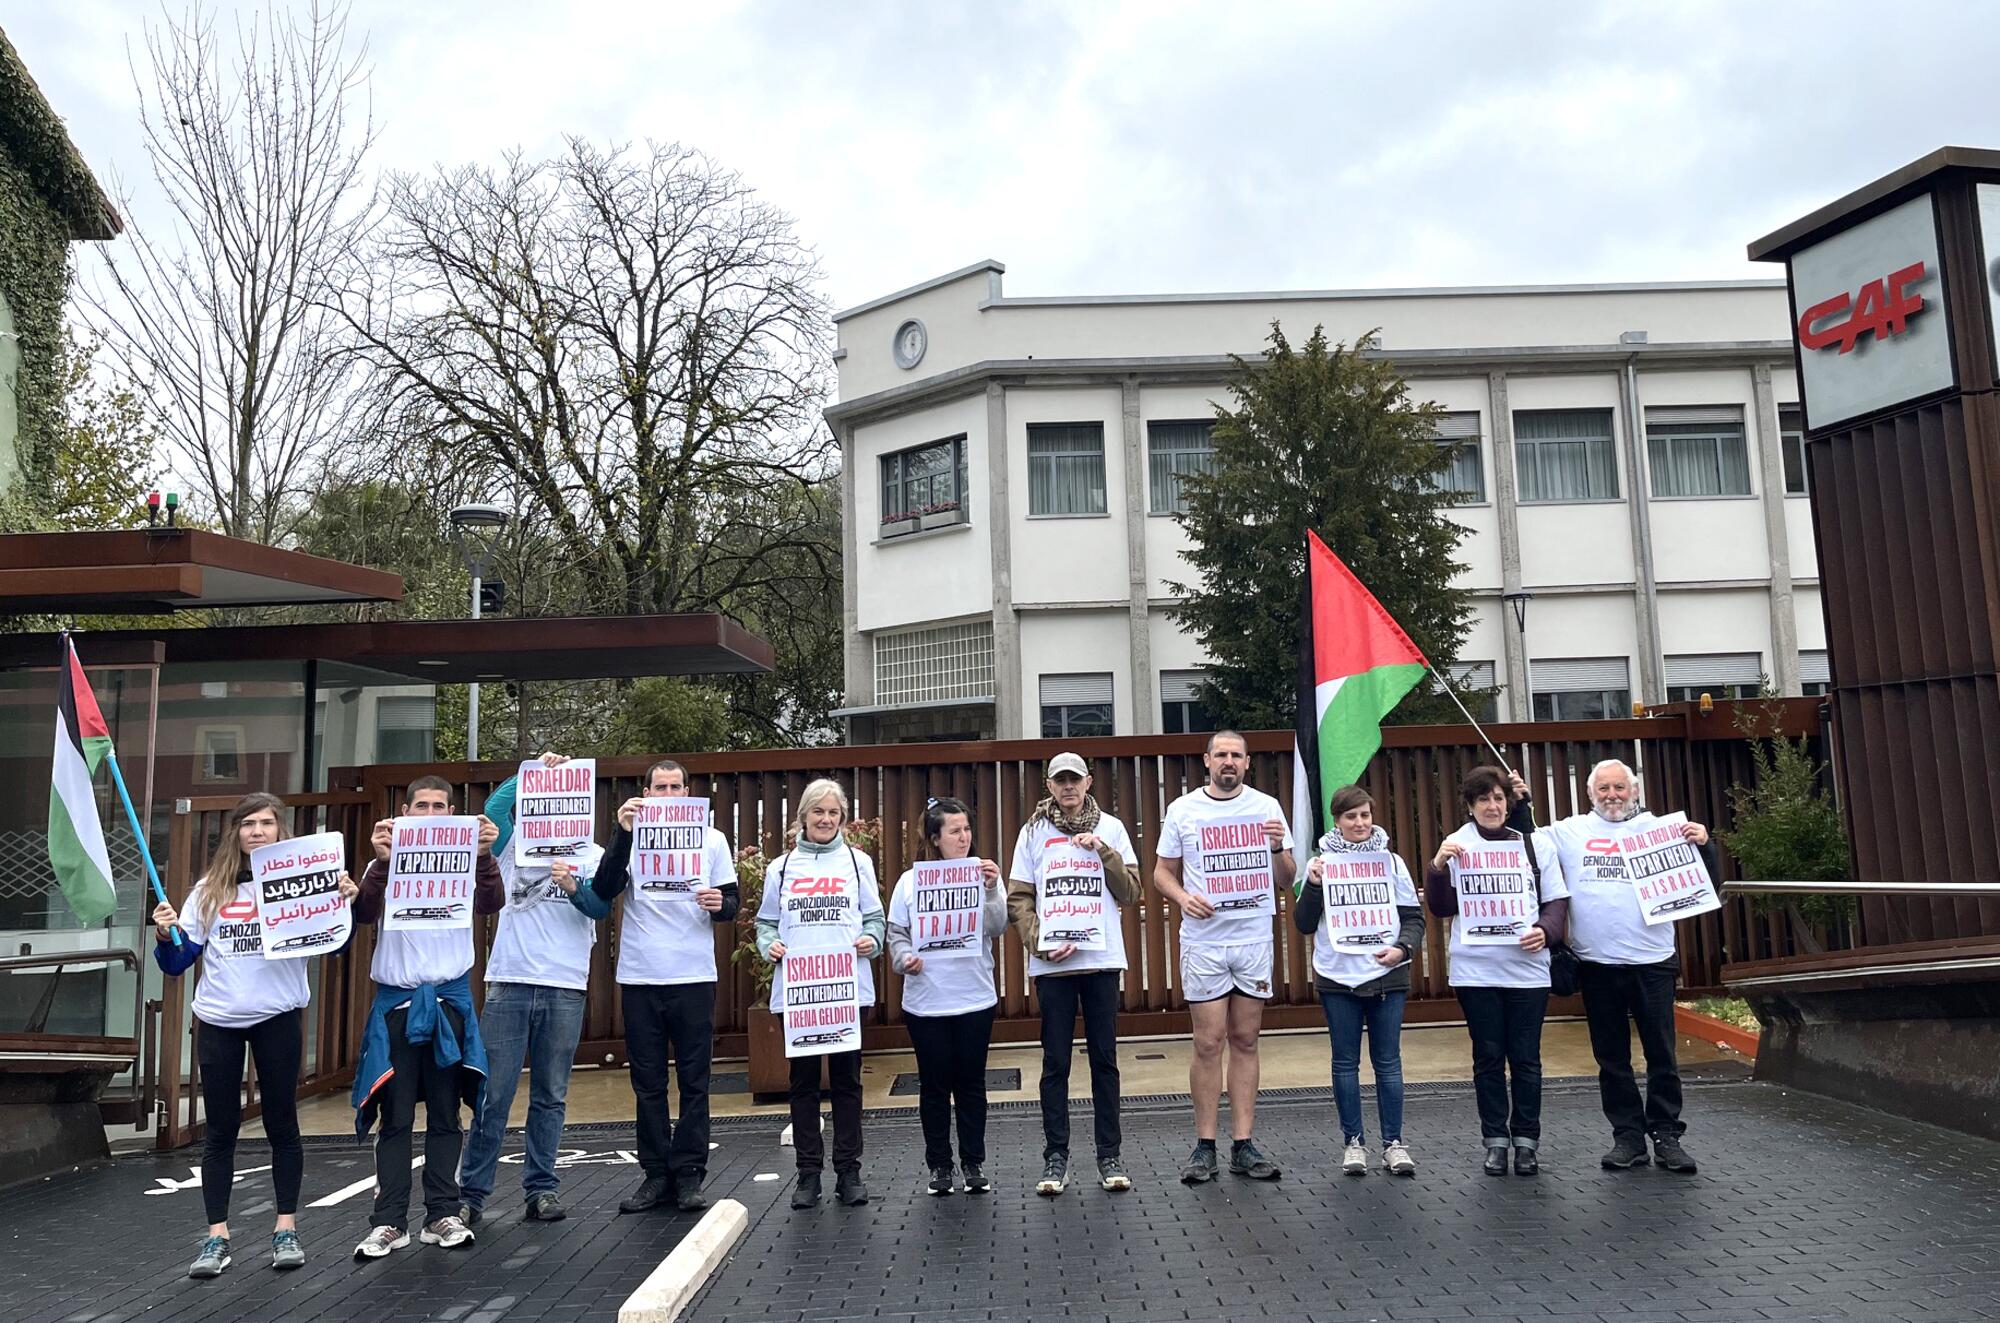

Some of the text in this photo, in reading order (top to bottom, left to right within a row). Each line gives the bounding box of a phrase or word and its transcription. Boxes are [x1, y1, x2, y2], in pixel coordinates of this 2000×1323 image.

[1798, 261, 1924, 355] CAF
[522, 768, 590, 793] ISRAELDAR
[523, 798, 590, 815] APARTHEIDAREN
[638, 805, 704, 822] STOP ISRAEL'S
[398, 827, 473, 847] NO AL TREN DE
[522, 820, 590, 838] TRENA GELDITU
[640, 828, 702, 848] APARTHEID
[1202, 823, 1266, 850] ISRAELDAR
[1622, 836, 1637, 852] NO
[1636, 833, 1648, 850] AL
[1646, 826, 1670, 846] TREN
[261, 854, 294, 876] قطار
[396, 852, 469, 873] L'APARTHEID
[640, 853, 702, 876] TRAIN
[1046, 856, 1067, 874] قطار
[1204, 852, 1267, 871] APARTHEIDAREN
[1472, 852, 1482, 869] AL
[1484, 852, 1508, 868] TREN
[1508, 851, 1520, 868] DE
[1631, 843, 1693, 878] APARTHEID
[918, 866, 980, 886] STOP ISRAEL'S
[1326, 862, 1386, 879] NO AL TREN DEL
[265, 870, 339, 900] لأبارتهايد
[393, 880, 468, 898] D'ISRAEL
[791, 878, 846, 896] CAF
[1206, 872, 1270, 894] TRENA GELDITU
[1462, 874, 1522, 894] L'APARTHEID
[1640, 868, 1704, 900] DE ISRAEL
[788, 896, 850, 911] GENOZIDIOAREN
[918, 888, 978, 911] APARTHEID
[1330, 884, 1388, 906] APARTHEID
[800, 908, 841, 922] KONPLIZE
[1332, 908, 1392, 928] DE ISRAEL
[1464, 900, 1526, 918] D'ISRAEL
[219, 923, 261, 940] GENOZID
[918, 912, 976, 938] TRAIN
[787, 952, 853, 982] ISRAELDAR
[788, 984, 854, 1004] APARTHEIDAREN
[788, 1005, 856, 1028] TRENA GELDITU
